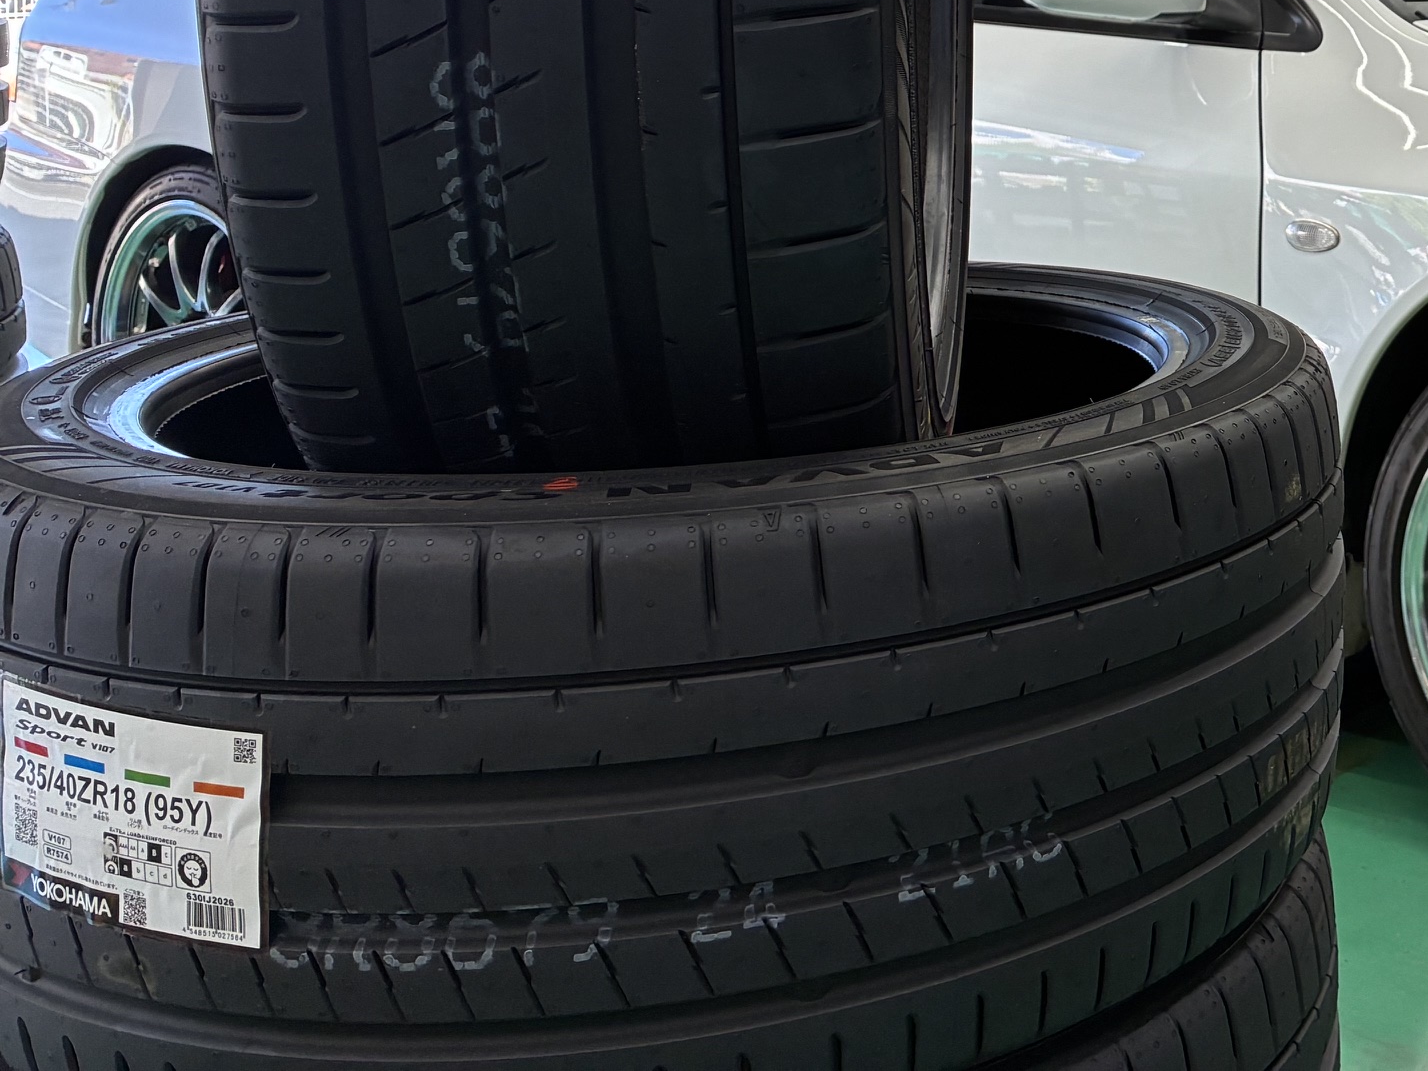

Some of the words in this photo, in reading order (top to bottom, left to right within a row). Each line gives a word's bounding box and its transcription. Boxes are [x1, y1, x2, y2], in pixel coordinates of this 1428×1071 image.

[15, 697, 116, 738] ADVAN
[15, 754, 137, 815] 235/40ZR18
[144, 791, 213, 836] (95Y)
[46, 846, 70, 861] R7574
[47, 833, 66, 846] V107
[30, 873, 112, 918] YOKOHAMA
